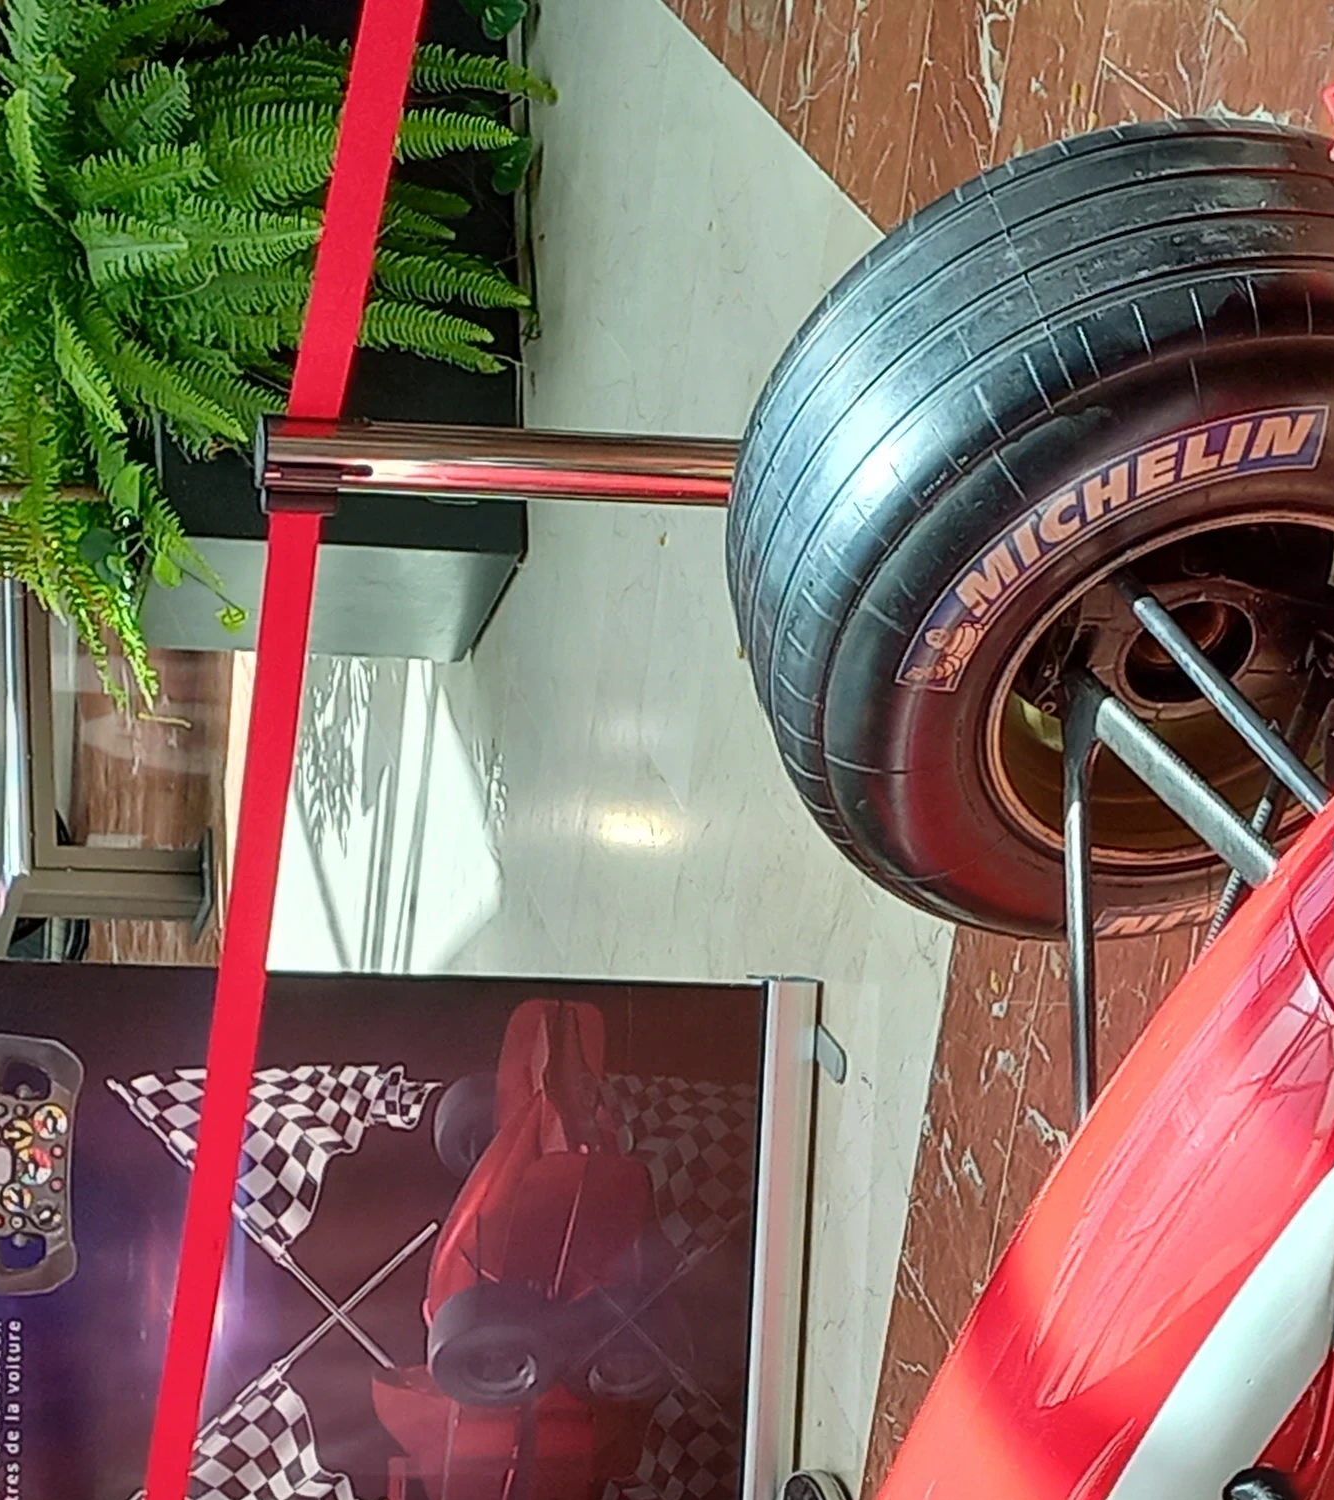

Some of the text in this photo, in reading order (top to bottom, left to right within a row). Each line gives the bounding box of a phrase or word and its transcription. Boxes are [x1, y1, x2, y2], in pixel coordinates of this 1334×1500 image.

[956, 411, 1320, 619] MICHELIN
[6, 1320, 21, 1393] voiture
[6, 1403, 20, 1421] la
[5, 1430, 19, 1454] de
